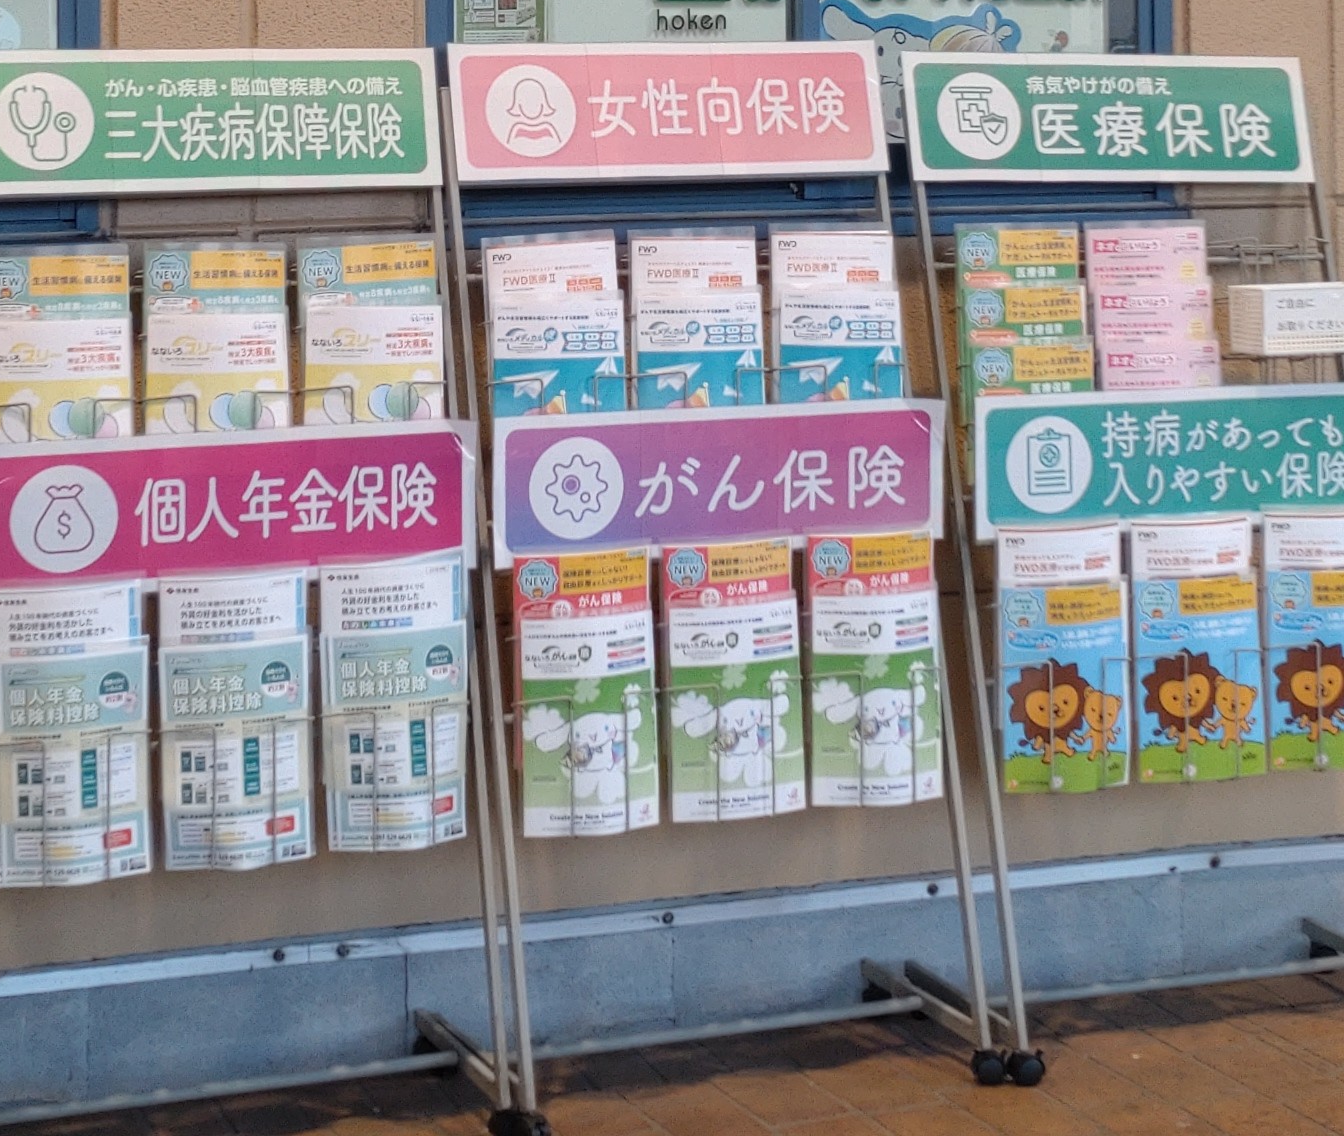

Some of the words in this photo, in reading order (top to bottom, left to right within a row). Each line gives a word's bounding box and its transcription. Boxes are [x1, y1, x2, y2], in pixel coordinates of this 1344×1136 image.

[656, 8, 728, 32] hoken
[104, 76, 404, 98] がん・心疾患・脳血管疾患への備え
[1025, 75, 1173, 96] 病気やけがの備え
[586, 76, 851, 138] 女性向保険
[103, 101, 407, 163] 三大疾病保障保険
[1030, 100, 1278, 159] 医療保険
[638, 246, 658, 254] FWD
[777, 240, 797, 249] FWD
[966, 247, 991, 258] NEW
[492, 253, 512, 262] FWD
[154, 267, 182, 280] NEW
[307, 264, 334, 277] NEW
[972, 304, 998, 315] NEW
[980, 363, 1006, 374] NEW
[1100, 410, 1344, 460] 持病があっても
[633, 443, 907, 519] がん保険
[133, 461, 439, 548] 個人年金保険
[674, 564, 701, 576] NEW
[869, 571, 910, 587] がん保険
[524, 576, 551, 587] NEW
[726, 582, 769, 596] がん保険
[577, 590, 623, 608] がん保険
[340, 658, 411, 681] 個人年金
[172, 674, 245, 696] 個人年金
[341, 675, 428, 699] 保険料控除
[9, 685, 84, 708] 個人年金
[172, 691, 263, 716] 保険料控除
[10, 702, 101, 727] 保険料控除
